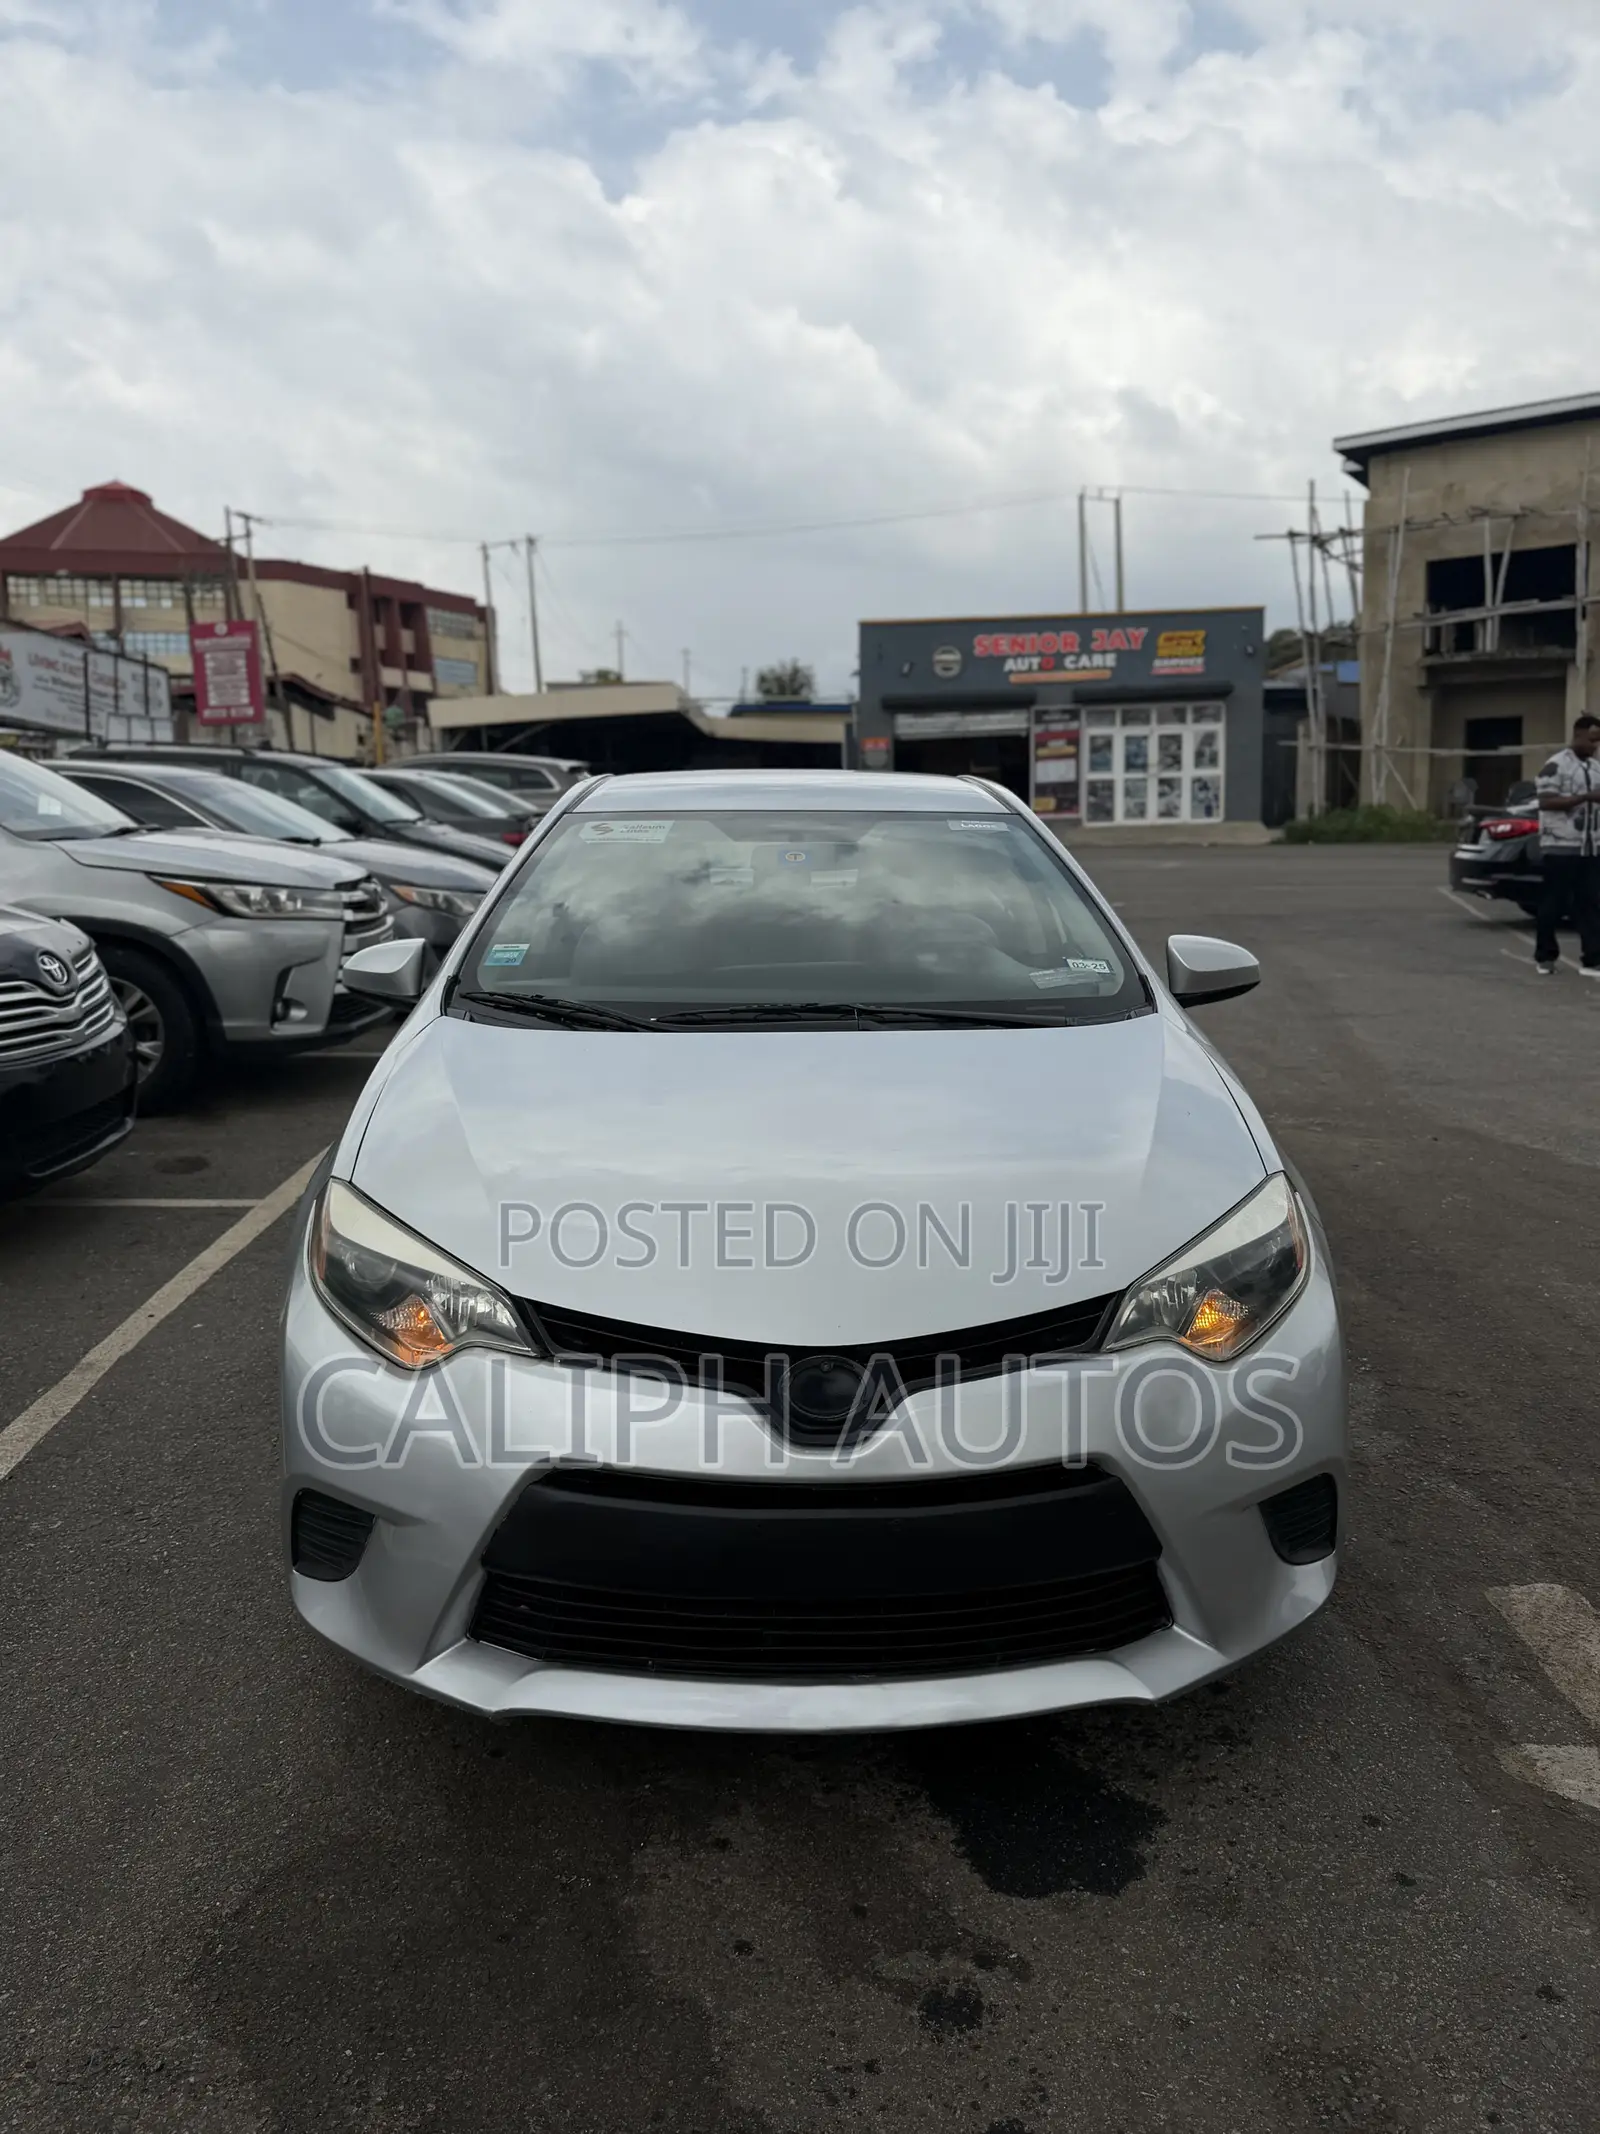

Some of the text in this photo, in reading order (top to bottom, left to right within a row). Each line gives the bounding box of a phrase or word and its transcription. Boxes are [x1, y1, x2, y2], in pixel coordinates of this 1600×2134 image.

[973, 631, 1081, 657] SENIOR
[1091, 628, 1148, 651] JAY
[1003, 653, 1117, 673] AUTO CARE
